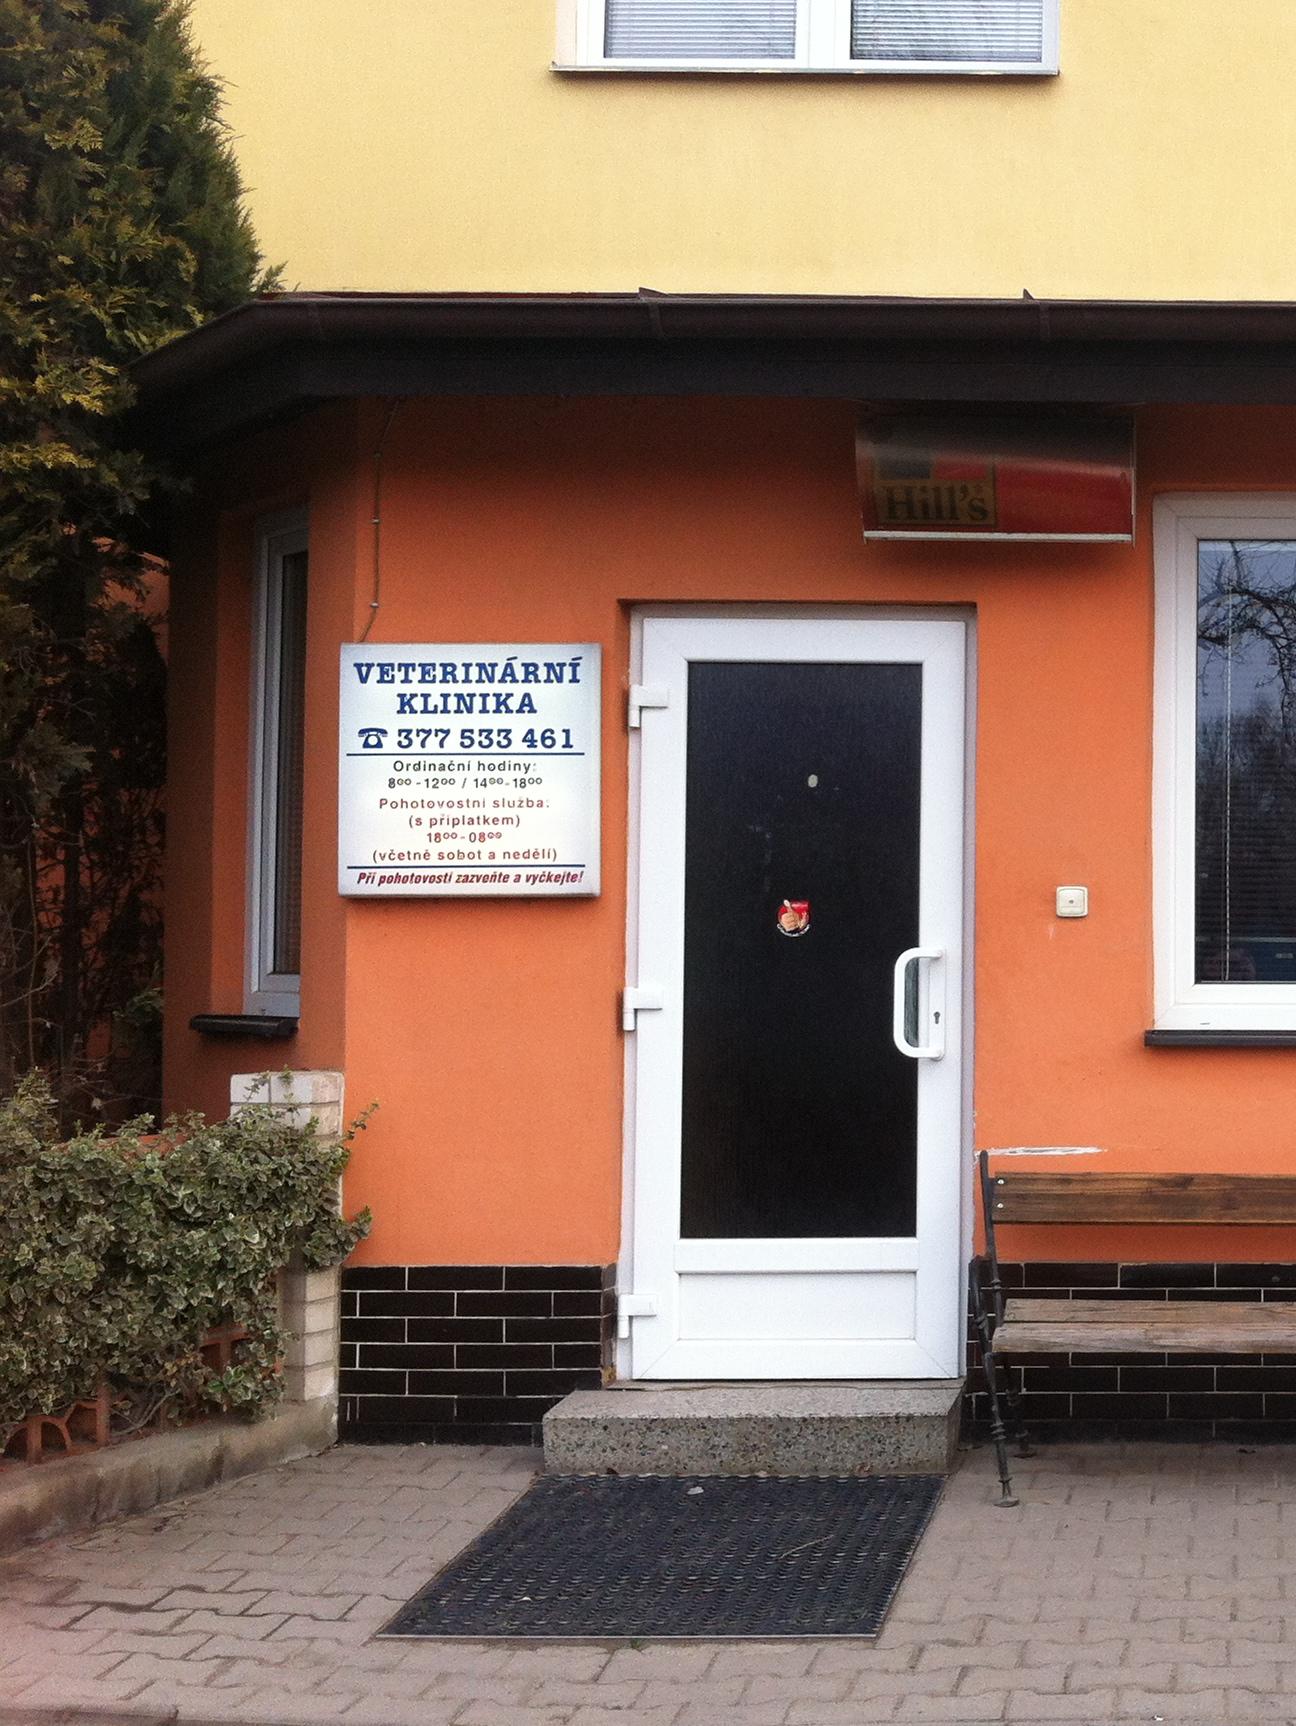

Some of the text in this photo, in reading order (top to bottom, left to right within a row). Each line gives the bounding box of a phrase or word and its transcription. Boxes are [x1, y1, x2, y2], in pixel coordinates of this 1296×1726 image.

[885, 483, 989, 521] Hill's
[353, 656, 583, 684] VETERINÁRNÍ
[396, 692, 538, 714] KLINIKA
[397, 728, 574, 749] 377 533 461
[393, 760, 537, 774] Ordinační hodiny:
[408, 814, 423, 828] (s
[437, 849, 482, 861] sobot
[488, 852, 496, 860] a
[513, 874, 521, 883] a
[525, 870, 584, 885] vyčkejte!
